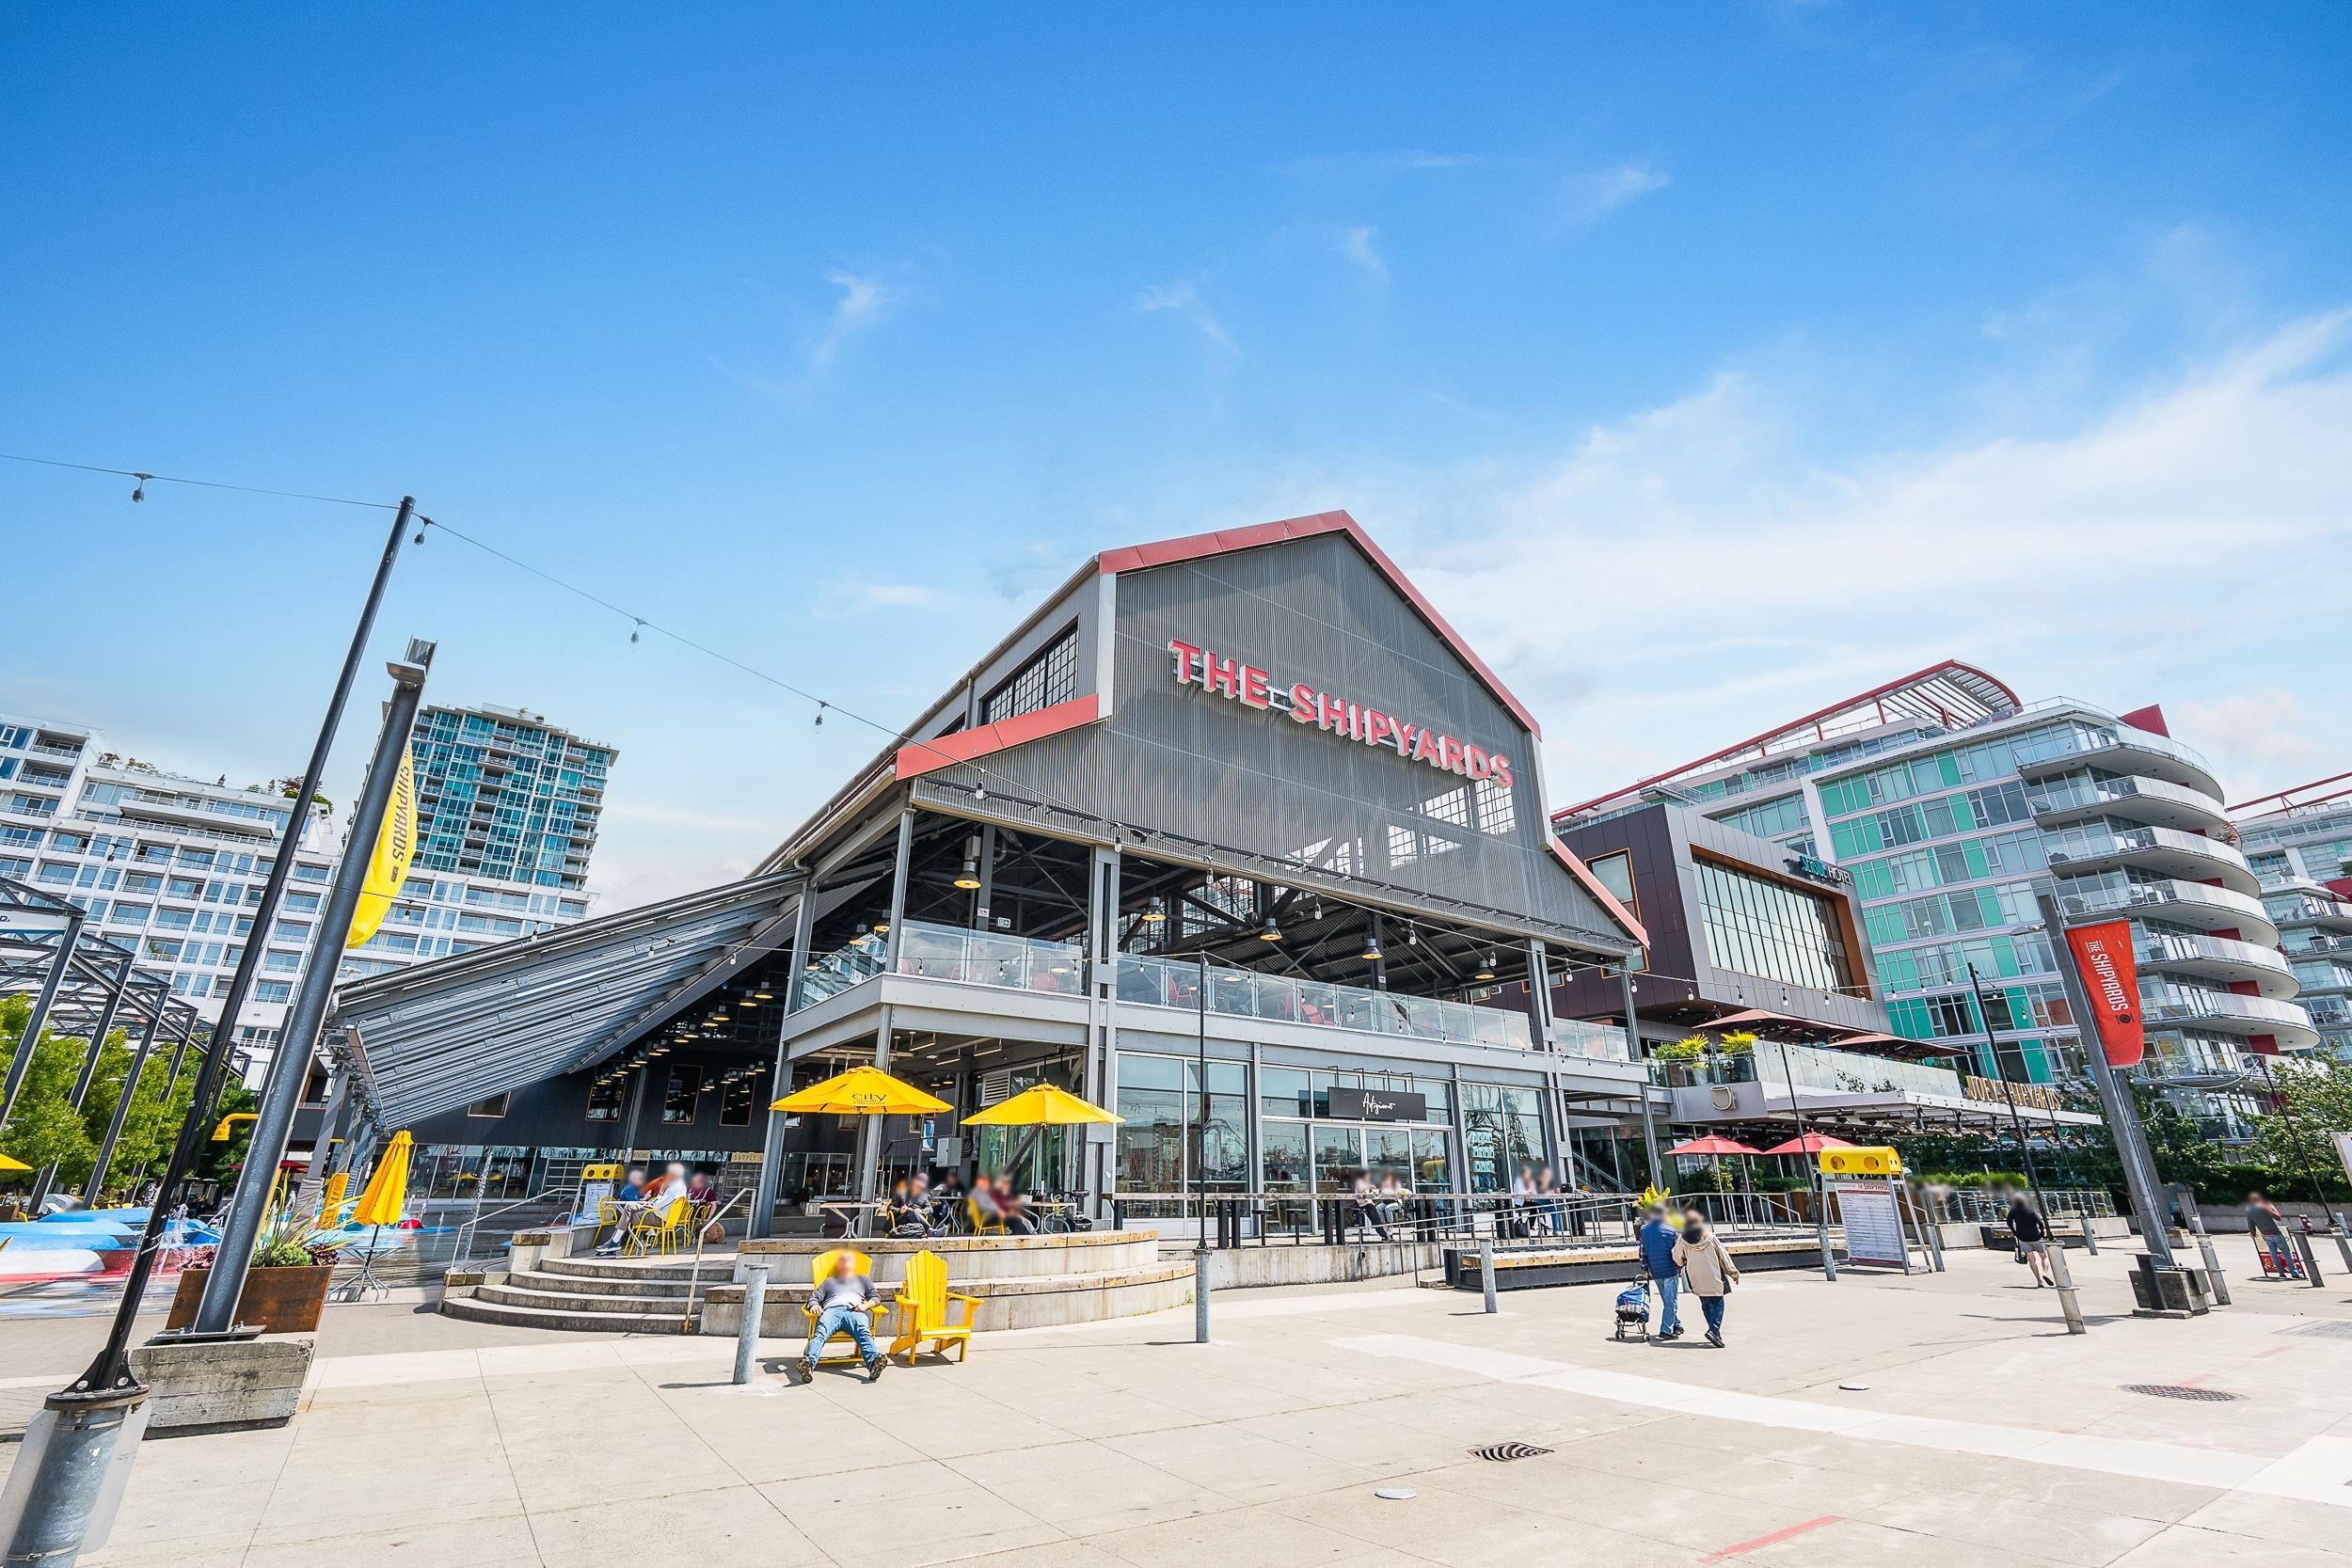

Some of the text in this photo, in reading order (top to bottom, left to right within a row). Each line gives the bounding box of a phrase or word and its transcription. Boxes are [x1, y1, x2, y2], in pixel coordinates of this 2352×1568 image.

[1168, 639, 1514, 788] THE SHIPYARDS
[392, 766, 409, 862] SHIPYARDS
[1828, 865, 1853, 885] HOTEL
[2088, 941, 2101, 953] THE
[2090, 953, 2129, 1012] SHIPYARDS
[1966, 1075, 1998, 1101] JOEY
